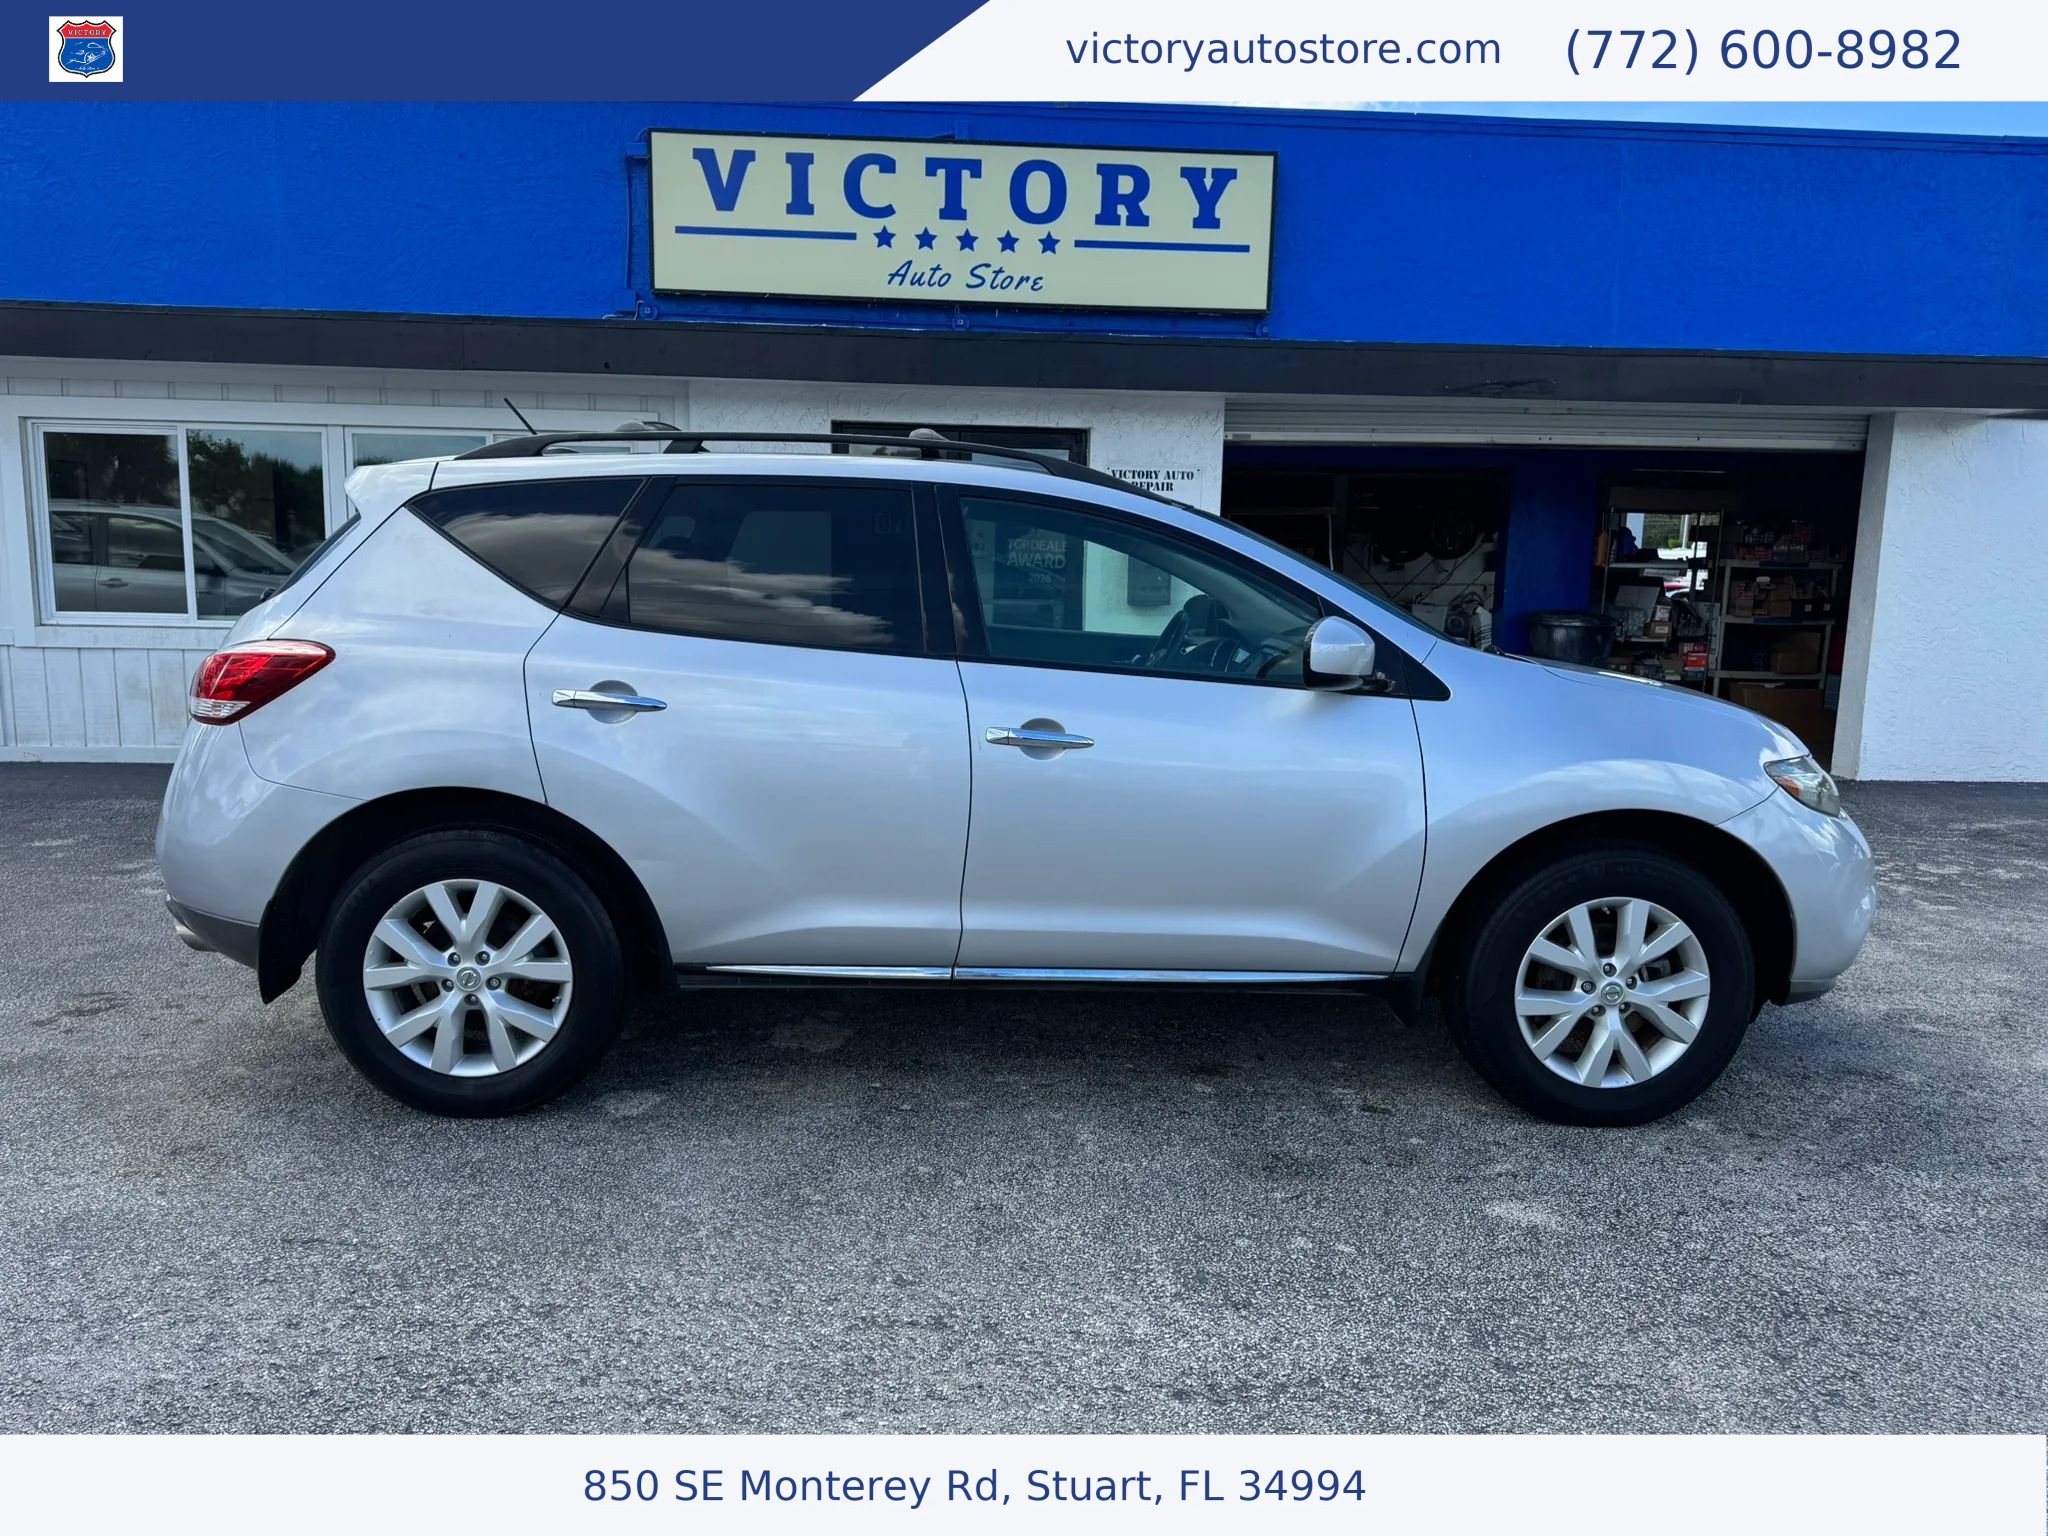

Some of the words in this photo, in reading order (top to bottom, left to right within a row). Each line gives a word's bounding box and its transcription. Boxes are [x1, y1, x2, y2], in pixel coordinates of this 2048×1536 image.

[692, 147, 1238, 230] VICTORY
[887, 259, 952, 288] Auto
[965, 262, 1044, 292] Store
[1111, 469, 1160, 480] VICTORY
[1164, 470, 1195, 480] AUTO
[1006, 551, 1067, 569] AWARD
